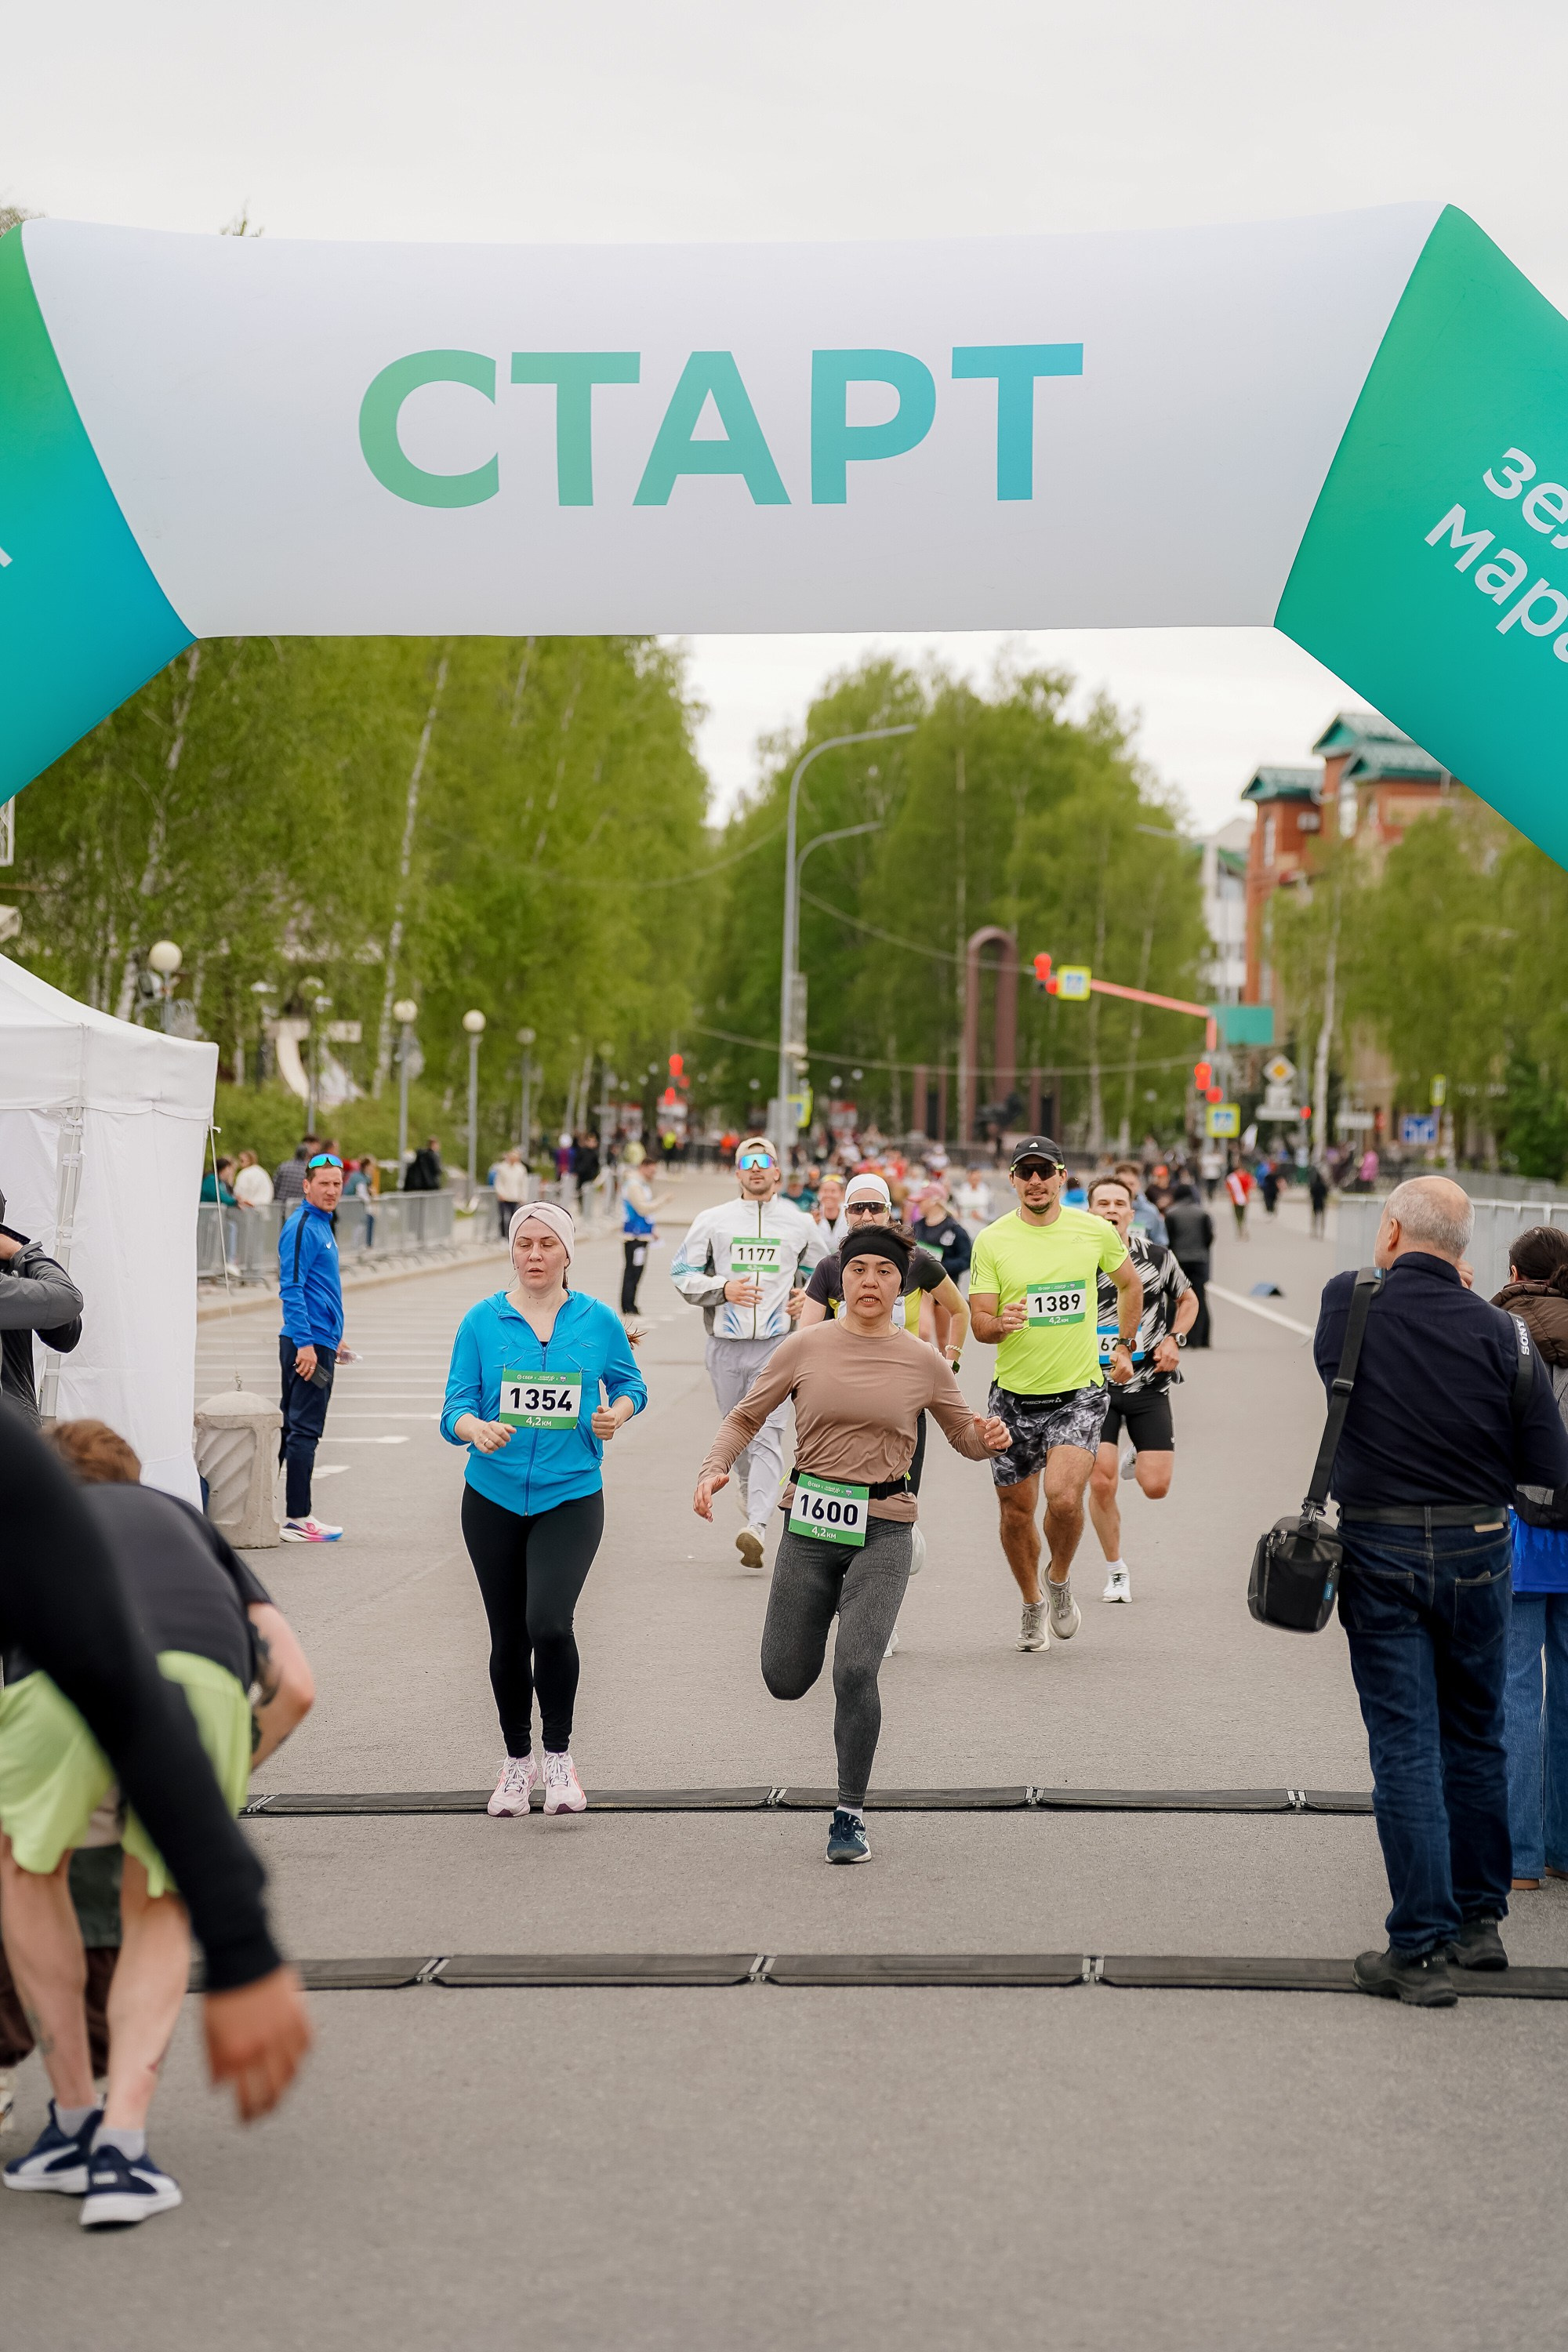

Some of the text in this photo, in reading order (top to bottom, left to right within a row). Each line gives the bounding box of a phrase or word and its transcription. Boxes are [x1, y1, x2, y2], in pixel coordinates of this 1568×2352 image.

[358, 343, 1083, 509] СТАРТ
[1483, 446, 1568, 550] зе
[739, 1247, 775, 1261] 1177
[1034, 1293, 1080, 1313] 1389
[1515, 1318, 1530, 1356] SONY
[510, 1387, 572, 1412] 1354
[800, 1494, 858, 1526] 1600
